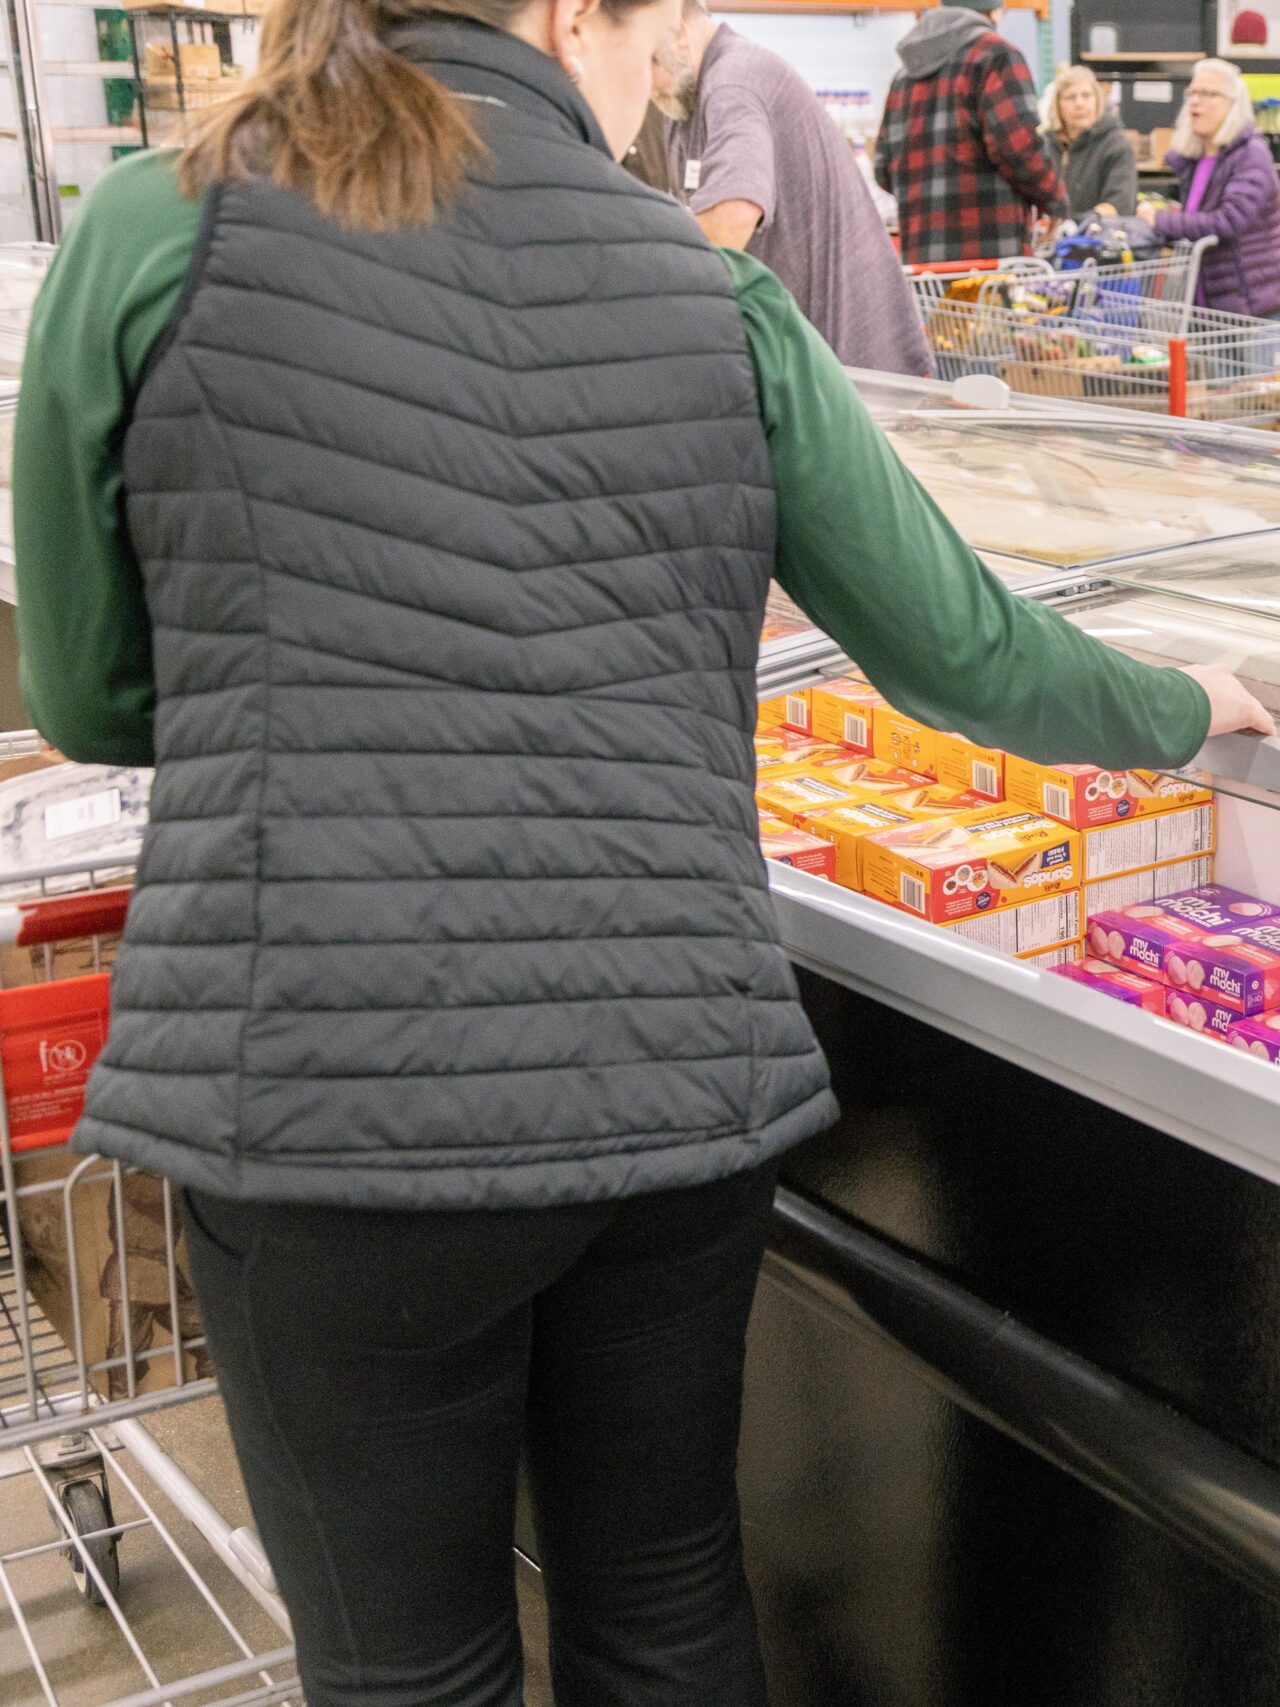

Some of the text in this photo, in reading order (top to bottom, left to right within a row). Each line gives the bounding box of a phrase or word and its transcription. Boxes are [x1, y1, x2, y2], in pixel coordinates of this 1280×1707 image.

[1022, 864, 1073, 888] Sandos
[1177, 896, 1222, 910] my
[1154, 898, 1231, 926] mochi
[1133, 937, 1149, 951] my
[1130, 945, 1160, 964] mochi
[1214, 966, 1229, 981] my
[1210, 976, 1241, 994] mochi
[1215, 1009, 1232, 1024] my
